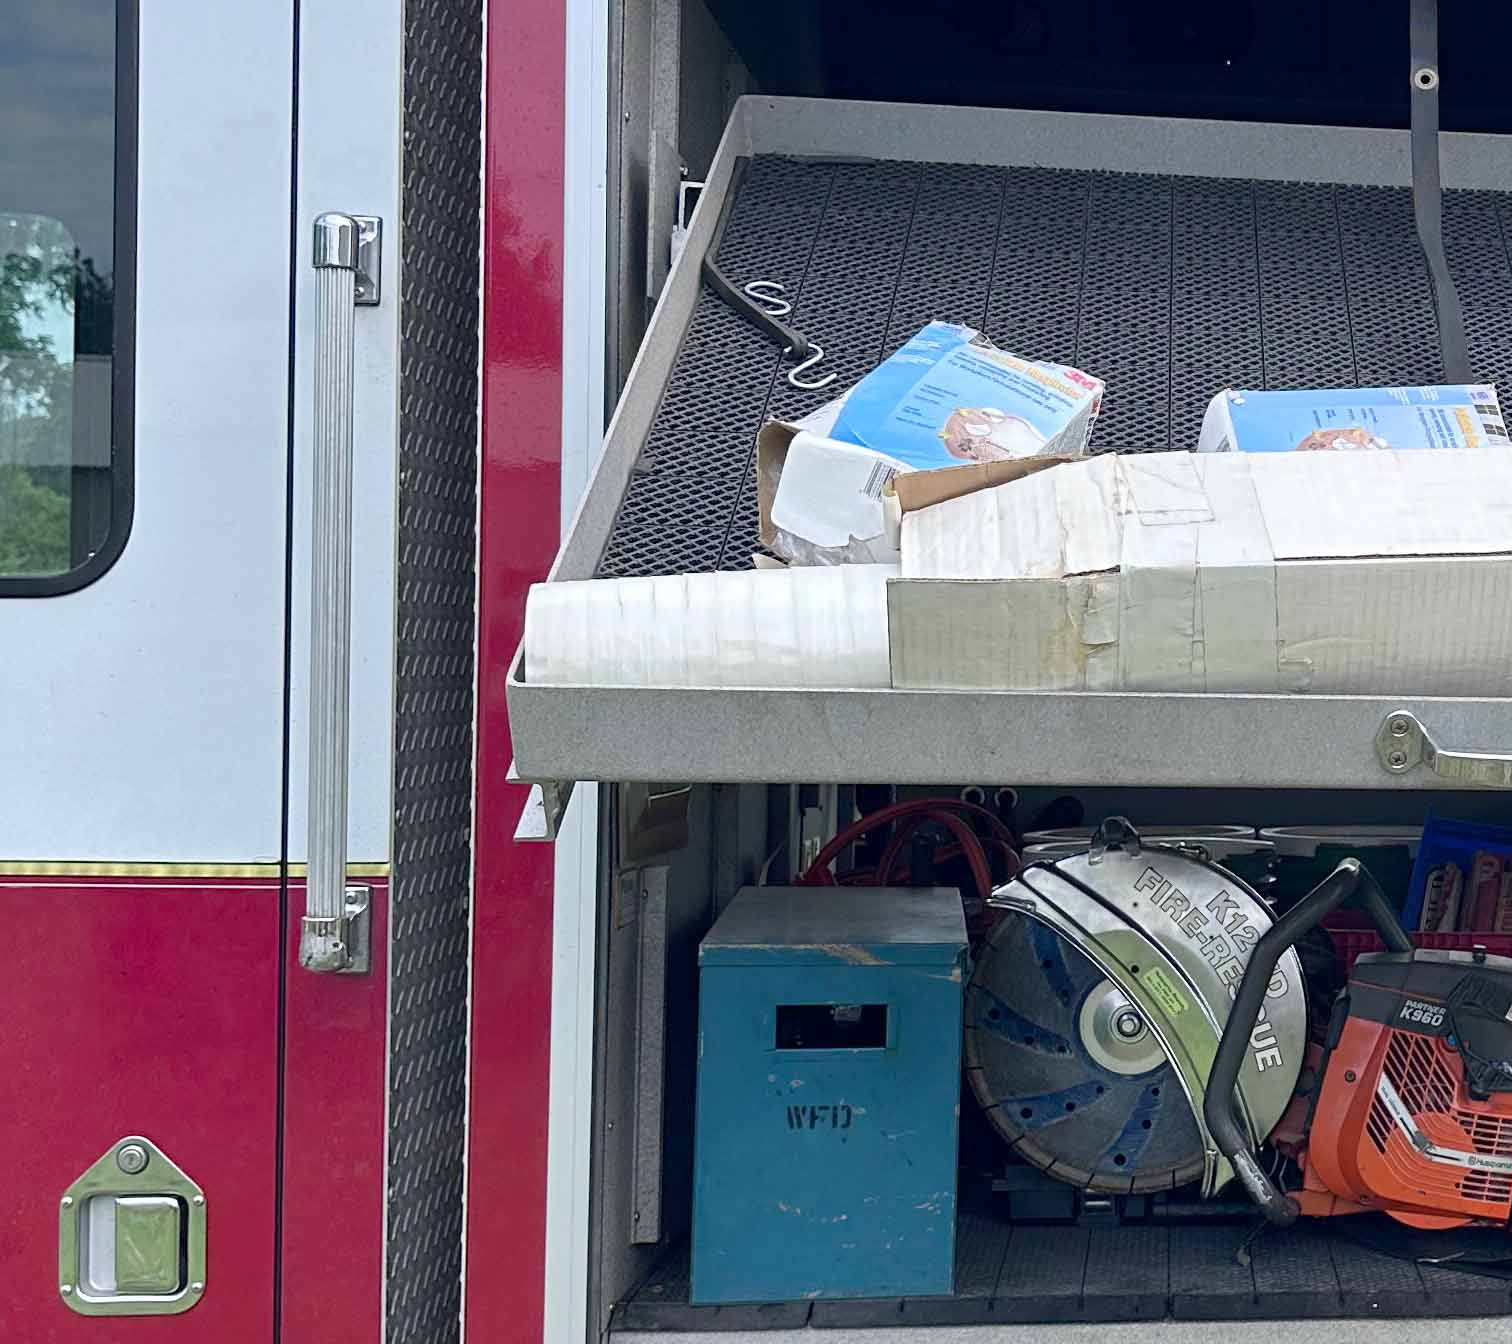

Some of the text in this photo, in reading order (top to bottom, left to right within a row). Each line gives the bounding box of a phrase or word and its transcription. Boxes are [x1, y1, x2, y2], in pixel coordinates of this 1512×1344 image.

[1206, 889, 1261, 954] K12
[1133, 866, 1284, 1073] FIRE-REUE
[1400, 1006, 1443, 1026] K960
[1405, 1000, 1447, 1015] PARTNER
[787, 1105, 851, 1129] WFD
